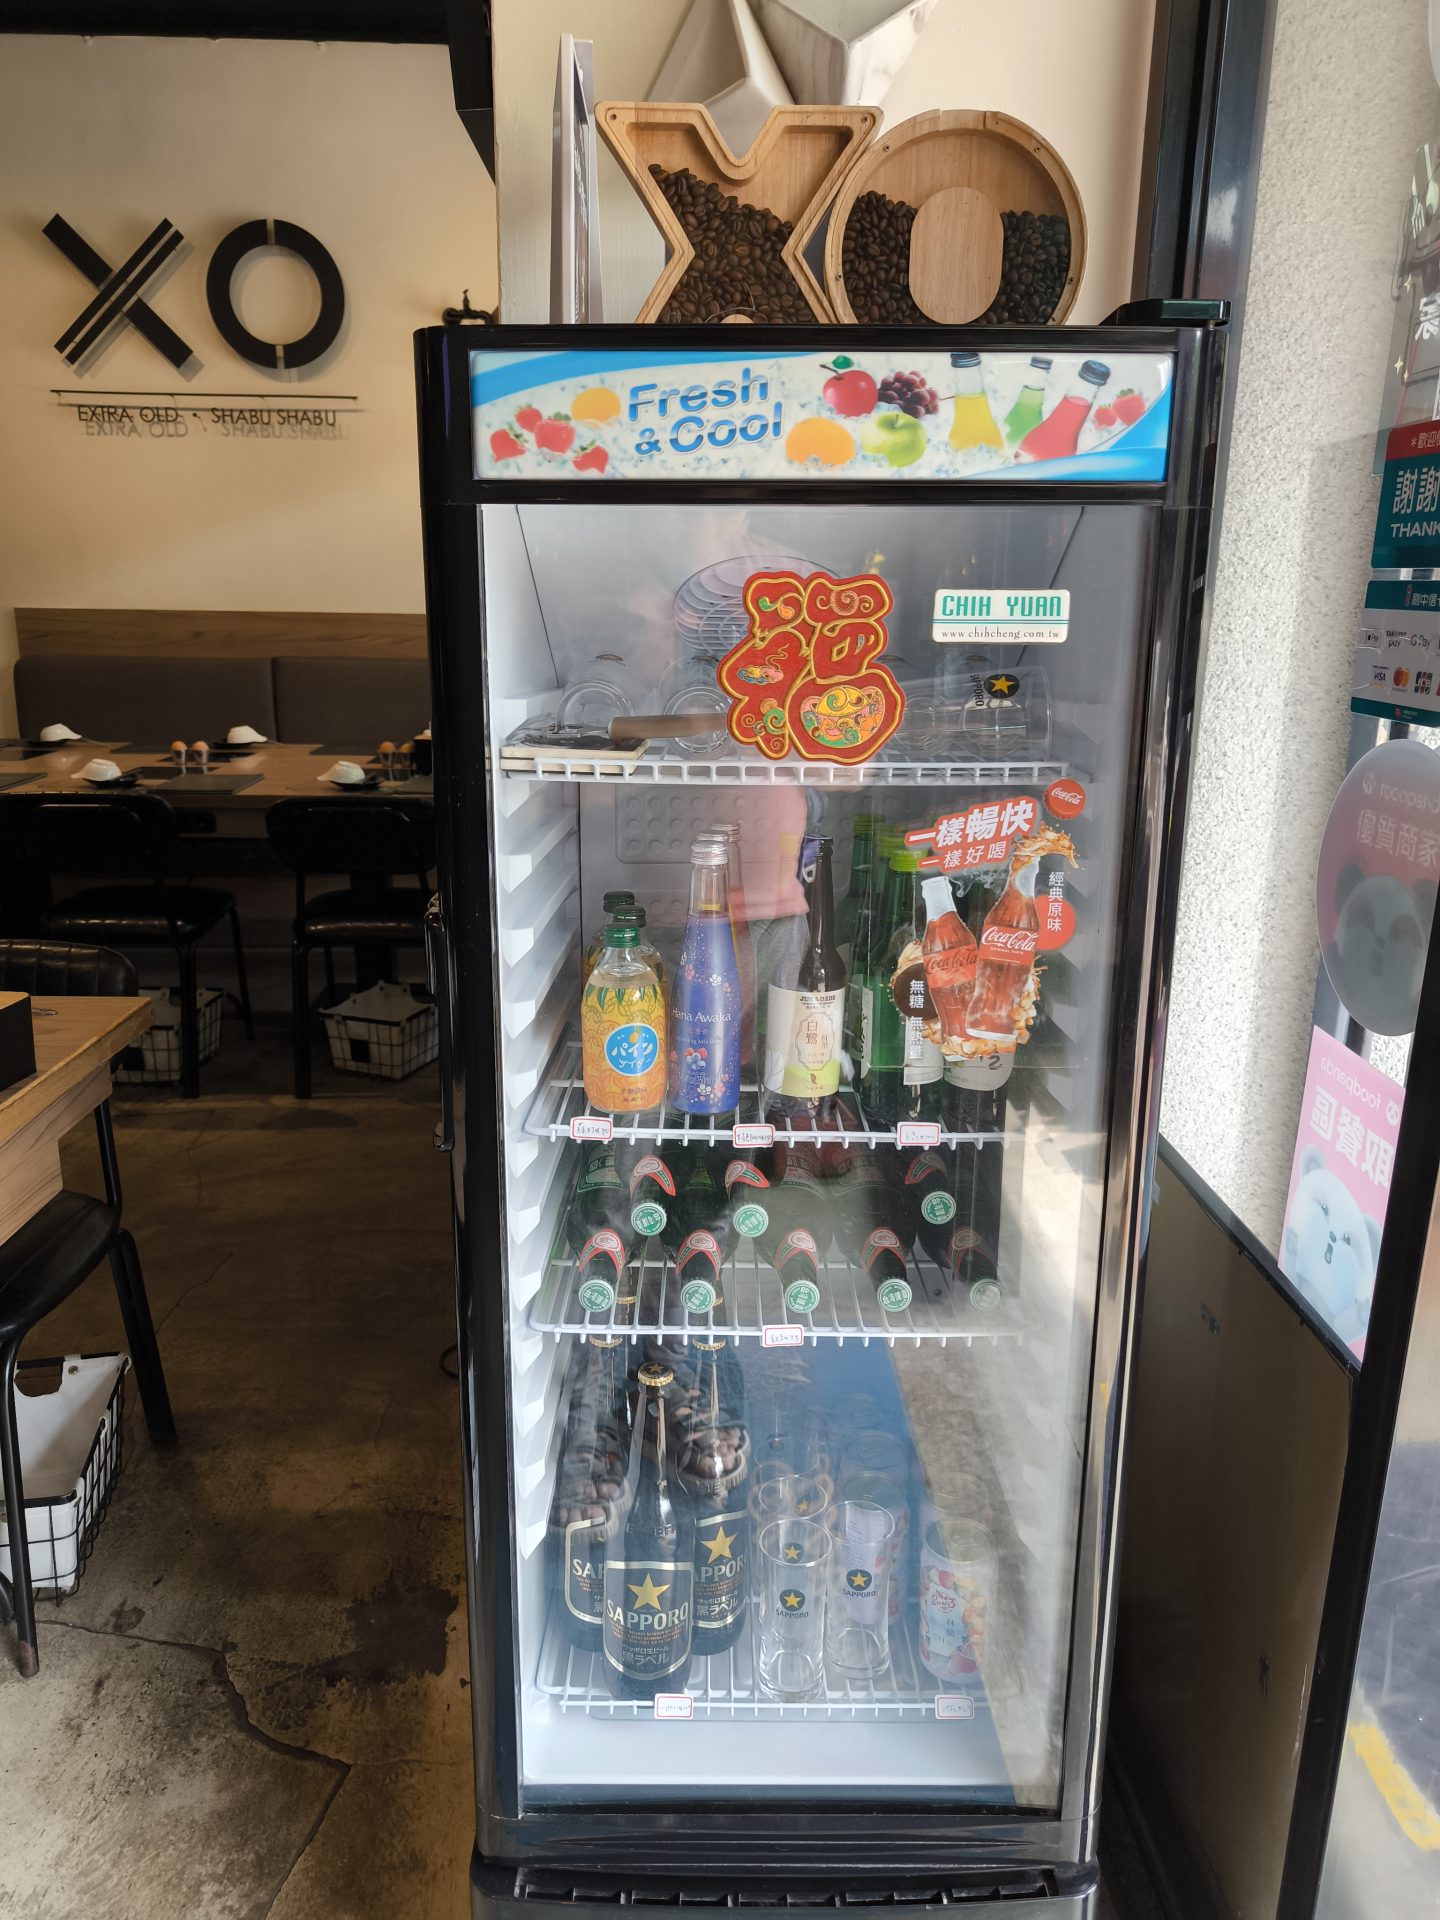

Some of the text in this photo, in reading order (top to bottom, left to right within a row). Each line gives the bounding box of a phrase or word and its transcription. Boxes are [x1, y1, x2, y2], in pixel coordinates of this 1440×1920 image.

[42, 213, 345, 369] XO
[628, 367, 769, 423] Fresh
[77, 405, 337, 427] EXTRA OLD SHABU SHABU
[634, 400, 784, 456] & Cool
[941, 595, 1062, 617] CHIH YUAN
[970, 673, 985, 707] SAPPORO
[909, 800, 1034, 848] 一樣暢快
[921, 841, 1007, 870] 一樣好喝
[1047, 871, 1065, 933] 經典原味
[908, 979, 925, 1009] 無糖
[672, 1005, 732, 1023] Hana Awaka
[611, 1042, 654, 1058] パイン
[843, 1589, 876, 1598] SAPPORO
[606, 1599, 689, 1631] SAPPORO
[775, 1609, 809, 1619] SAPPORO
